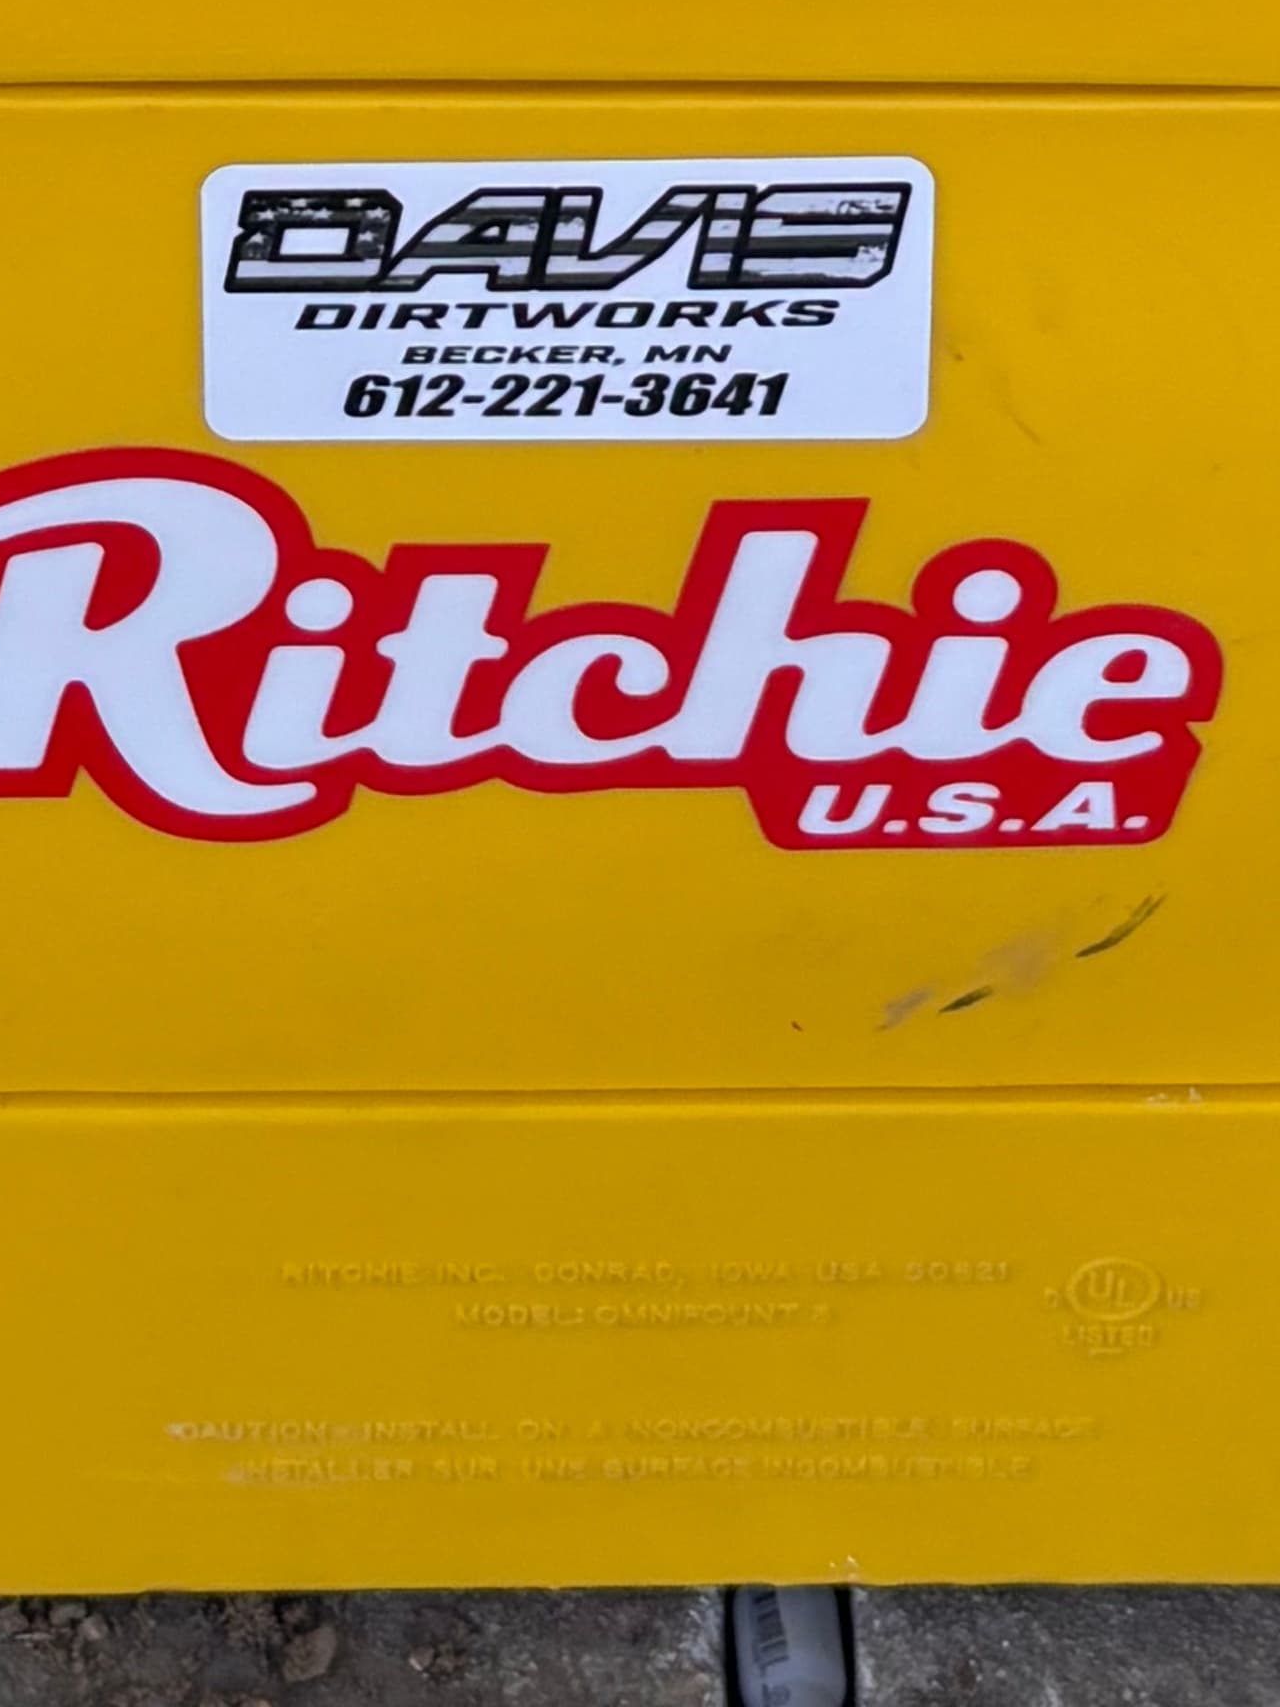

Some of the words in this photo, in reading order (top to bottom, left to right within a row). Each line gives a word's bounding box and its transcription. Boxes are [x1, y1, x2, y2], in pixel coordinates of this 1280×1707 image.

[223, 182, 912, 292] DAVIS
[295, 300, 840, 330] DIRTWORKS
[400, 345, 625, 366] BECKER,
[644, 344, 731, 364] MN
[343, 371, 790, 418] 612-221-3641
[797, 782, 1148, 836] U.S.A.
[282, 1261, 417, 1284] RITCHIE
[816, 1260, 882, 1283] USA
[1087, 1269, 1135, 1308] UL
[1062, 1324, 1153, 1347] LISTED
